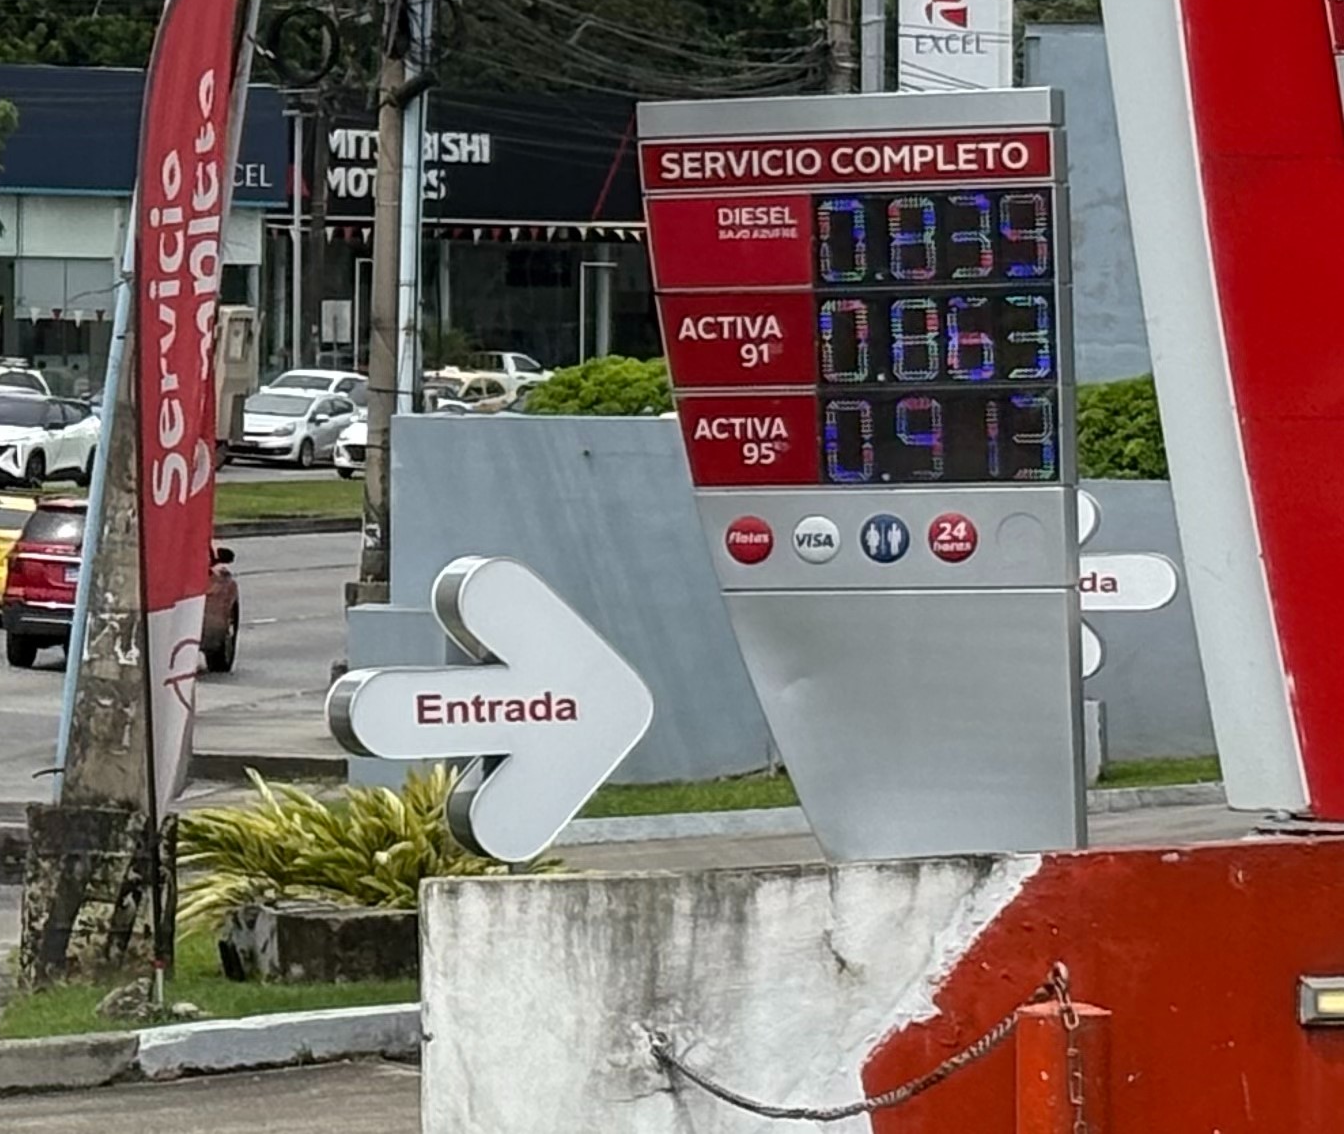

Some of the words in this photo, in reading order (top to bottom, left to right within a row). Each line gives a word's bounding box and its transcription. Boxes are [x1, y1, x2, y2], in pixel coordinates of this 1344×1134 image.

[915, 33, 989, 55] EXCEL
[660, 147, 822, 181] SERVICIO
[830, 141, 1030, 176] COMPLETO
[717, 206, 798, 226] DIESEL
[149, 149, 190, 507] Servicio
[678, 314, 784, 341] ACTIVA
[739, 343, 770, 368] 91
[693, 416, 789, 440] ACTIVA
[742, 442, 776, 465] 95
[796, 533, 834, 548] VISA
[937, 521, 967, 541] 24
[416, 691, 578, 726] Entrada
